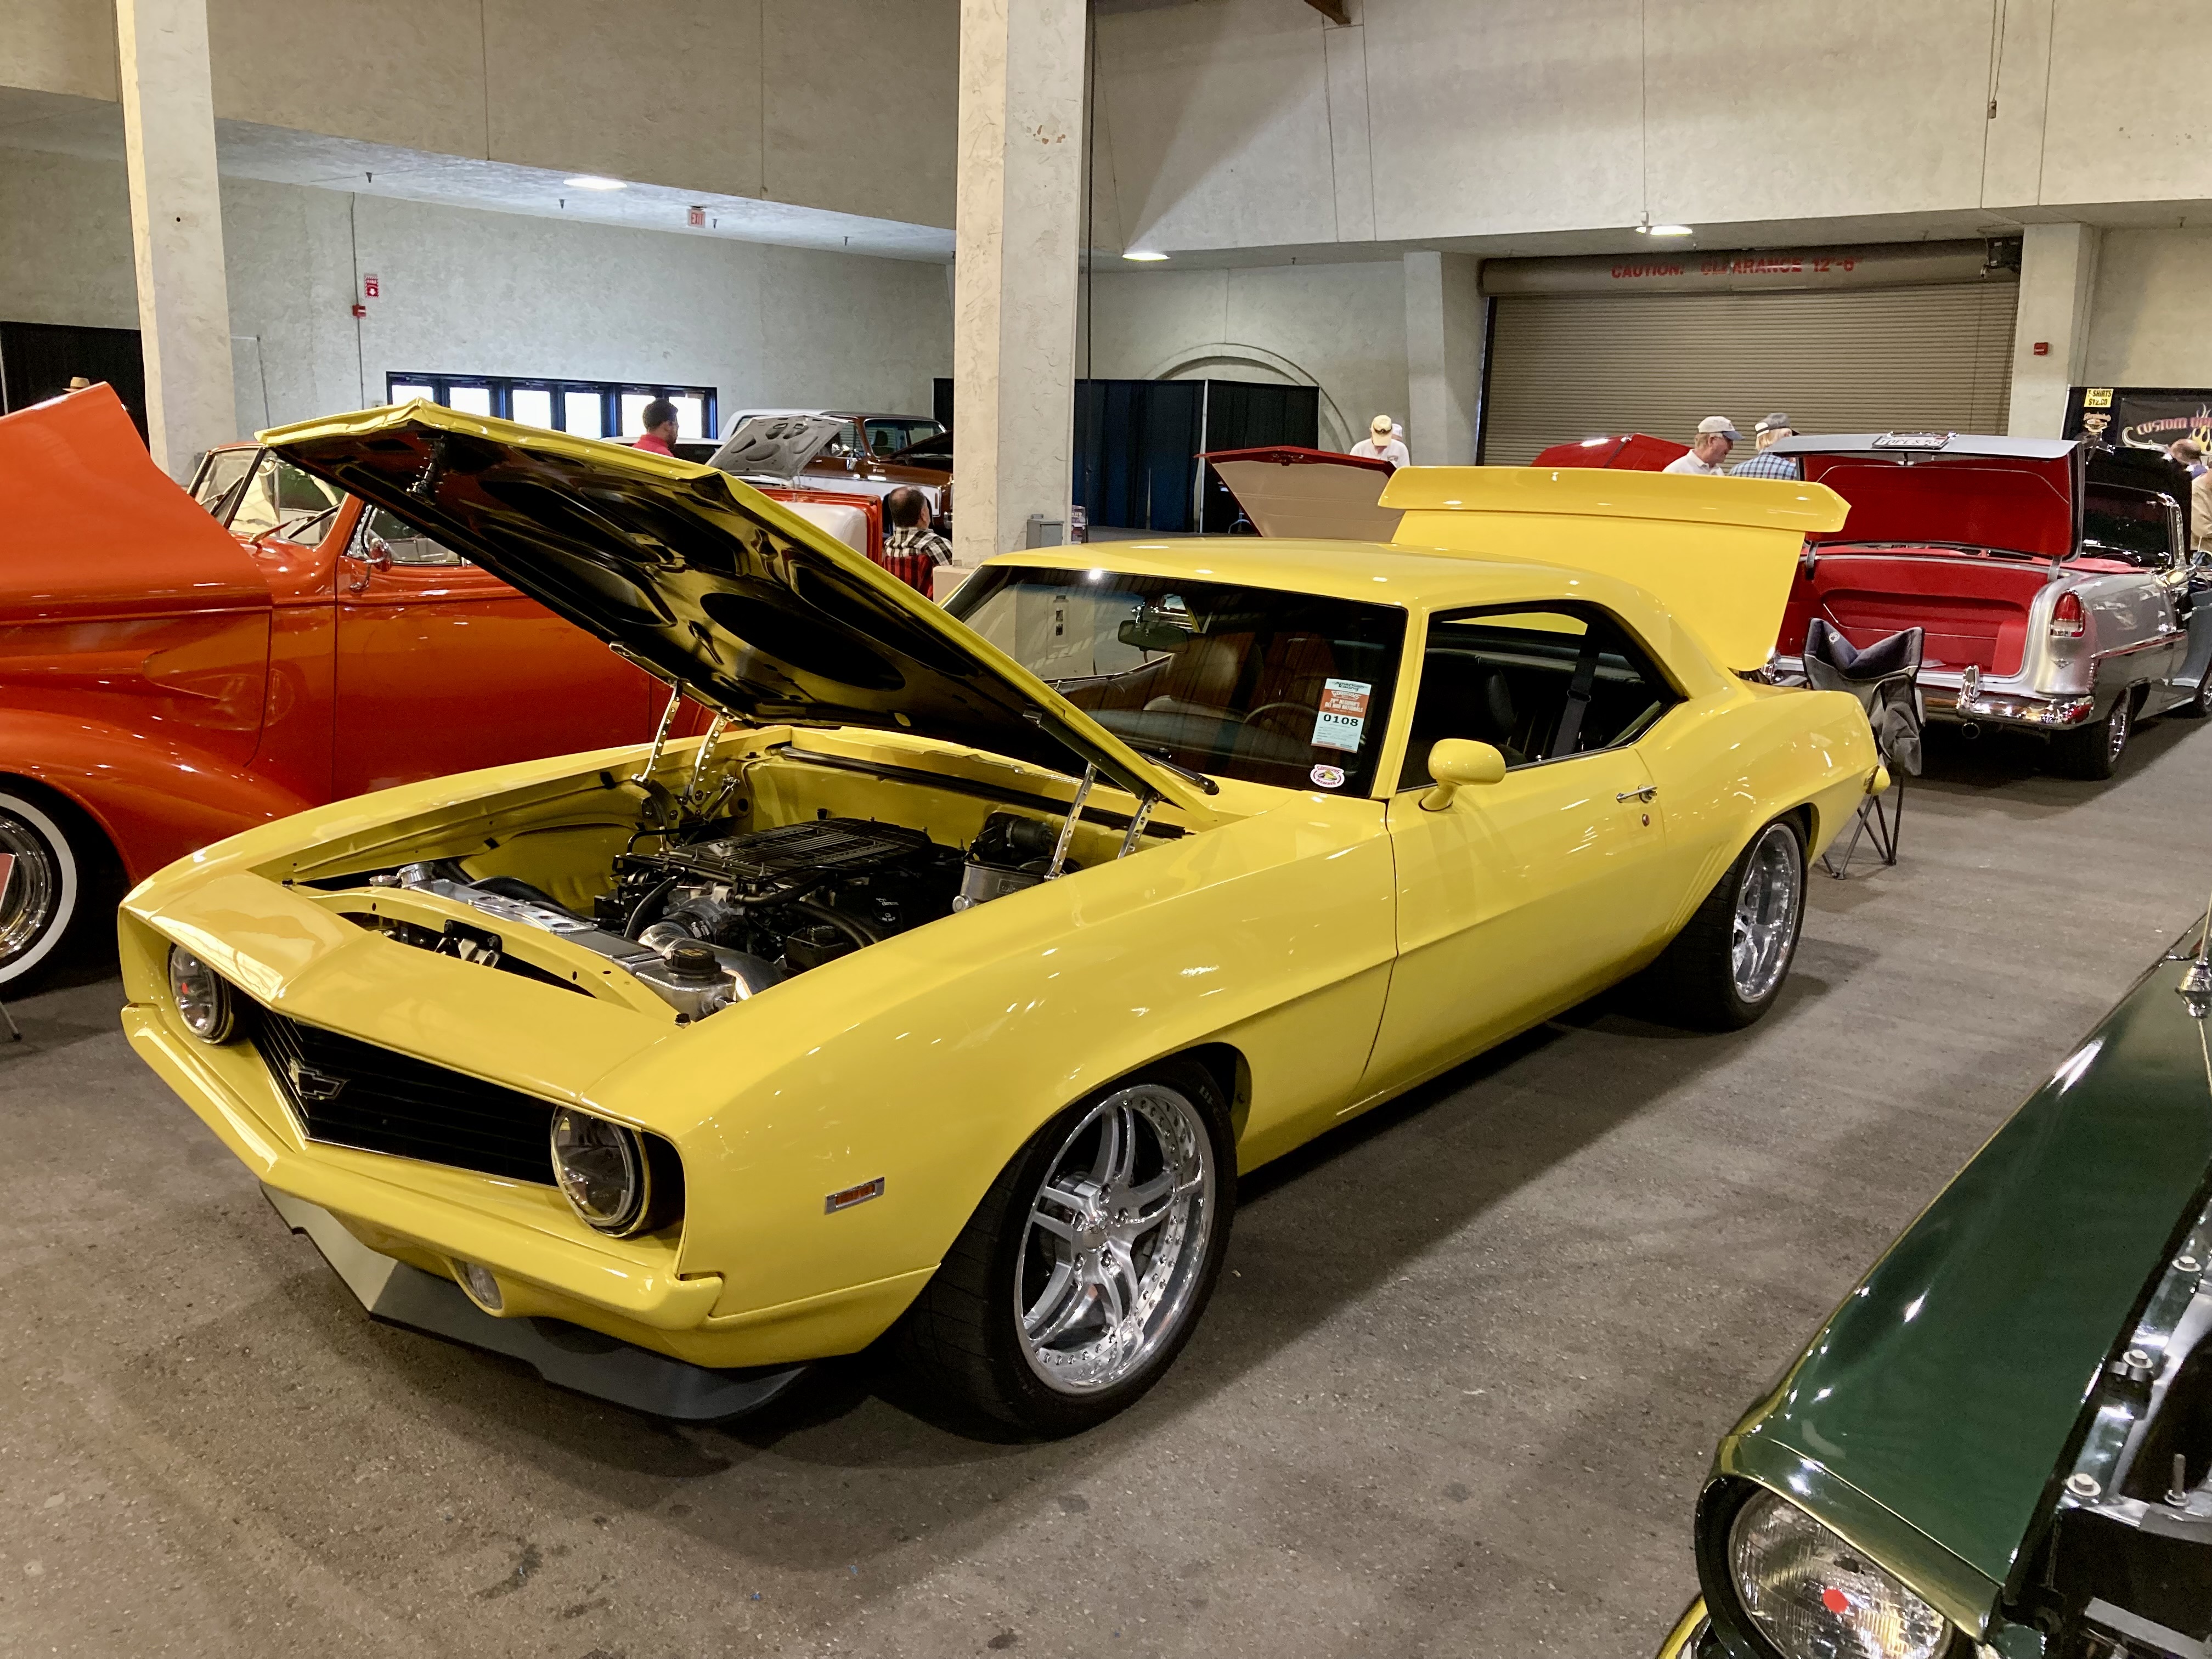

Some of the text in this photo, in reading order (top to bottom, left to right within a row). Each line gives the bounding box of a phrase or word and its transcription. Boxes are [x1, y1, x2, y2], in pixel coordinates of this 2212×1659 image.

[2137, 417, 2187, 435] CUSTOM
[1331, 691, 1362, 699] GOODGUYS
[1323, 714, 1359, 726] 0108
